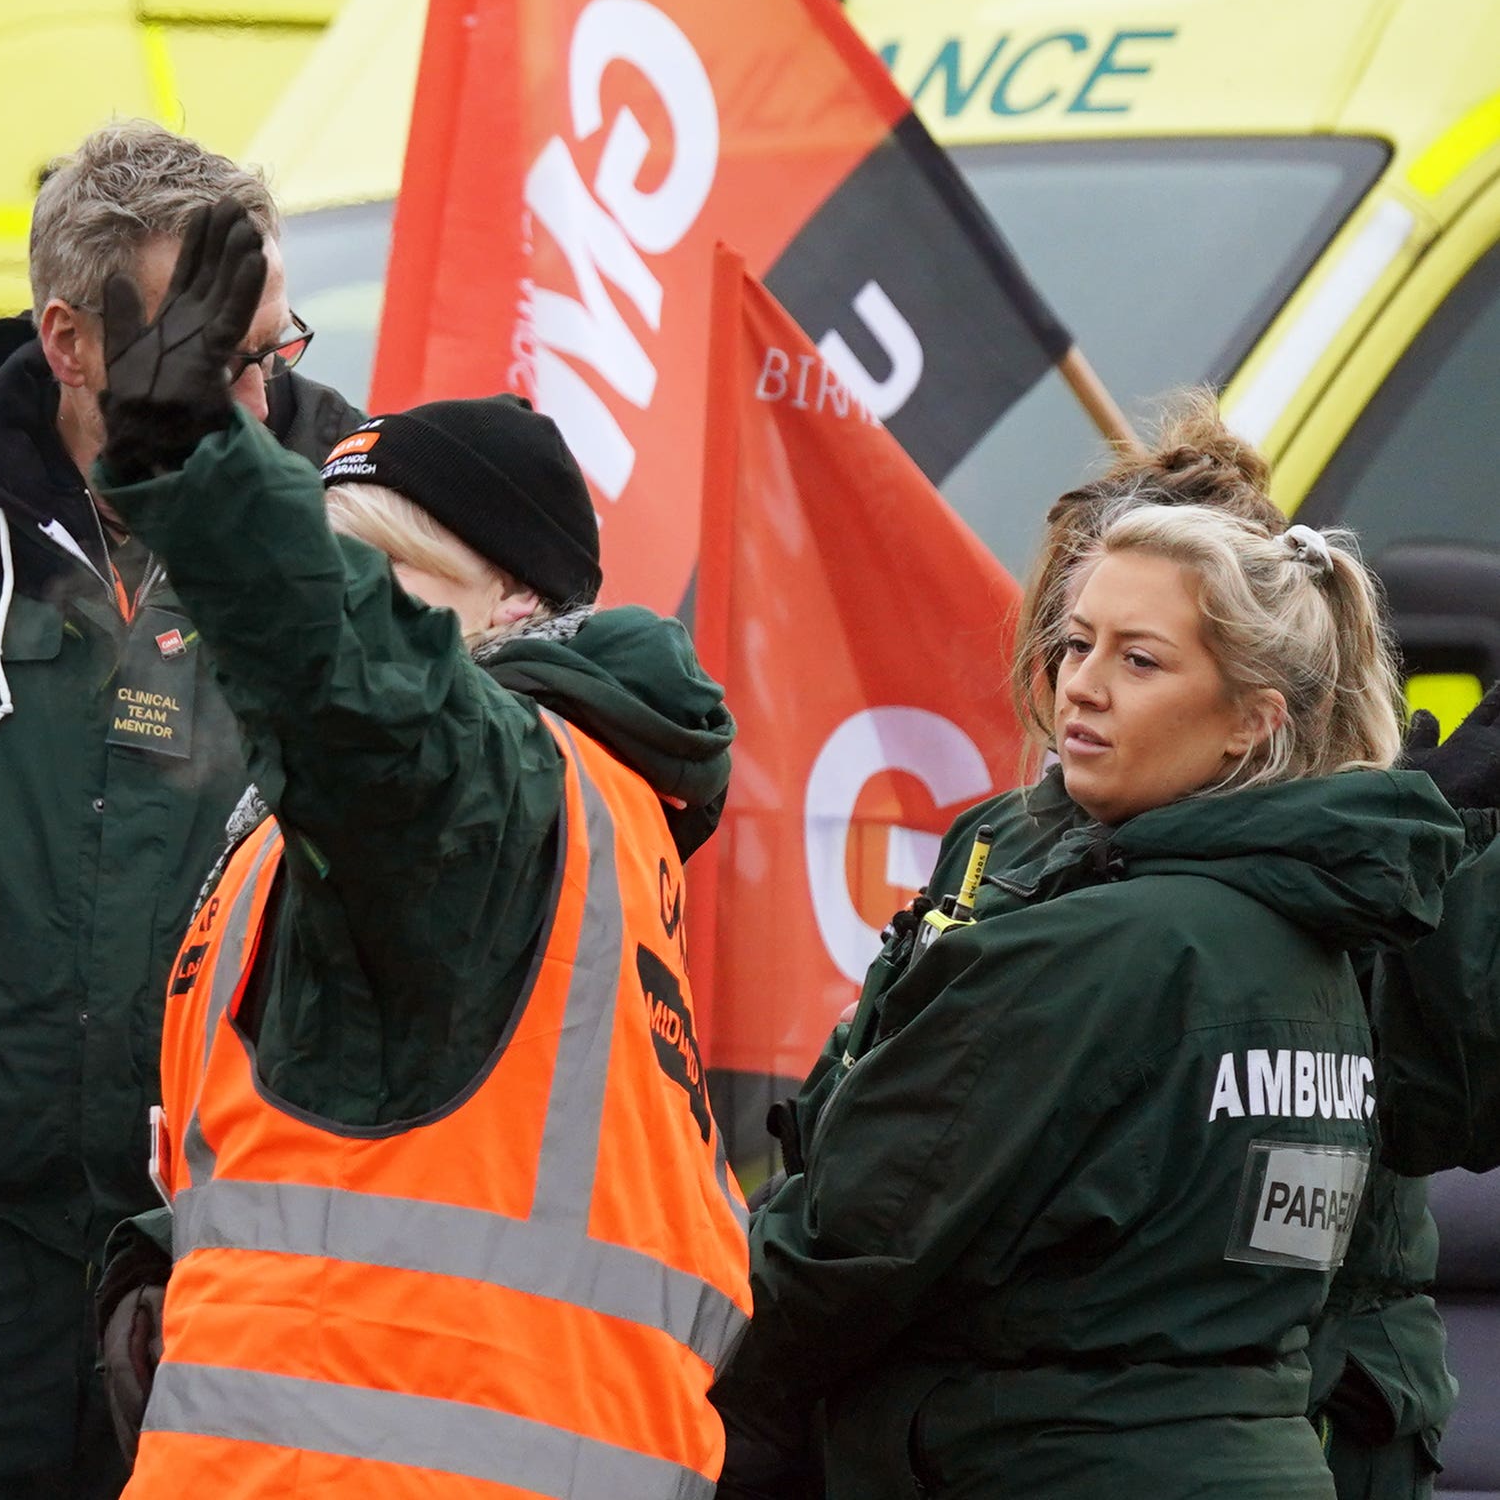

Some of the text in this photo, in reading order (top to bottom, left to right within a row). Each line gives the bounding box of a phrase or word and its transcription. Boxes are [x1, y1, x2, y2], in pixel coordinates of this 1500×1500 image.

[334, 463, 377, 476] BRANCH
[117, 687, 180, 712] CLINICAL
[127, 704, 167, 724] TEAM
[114, 717, 173, 740] MENTOR
